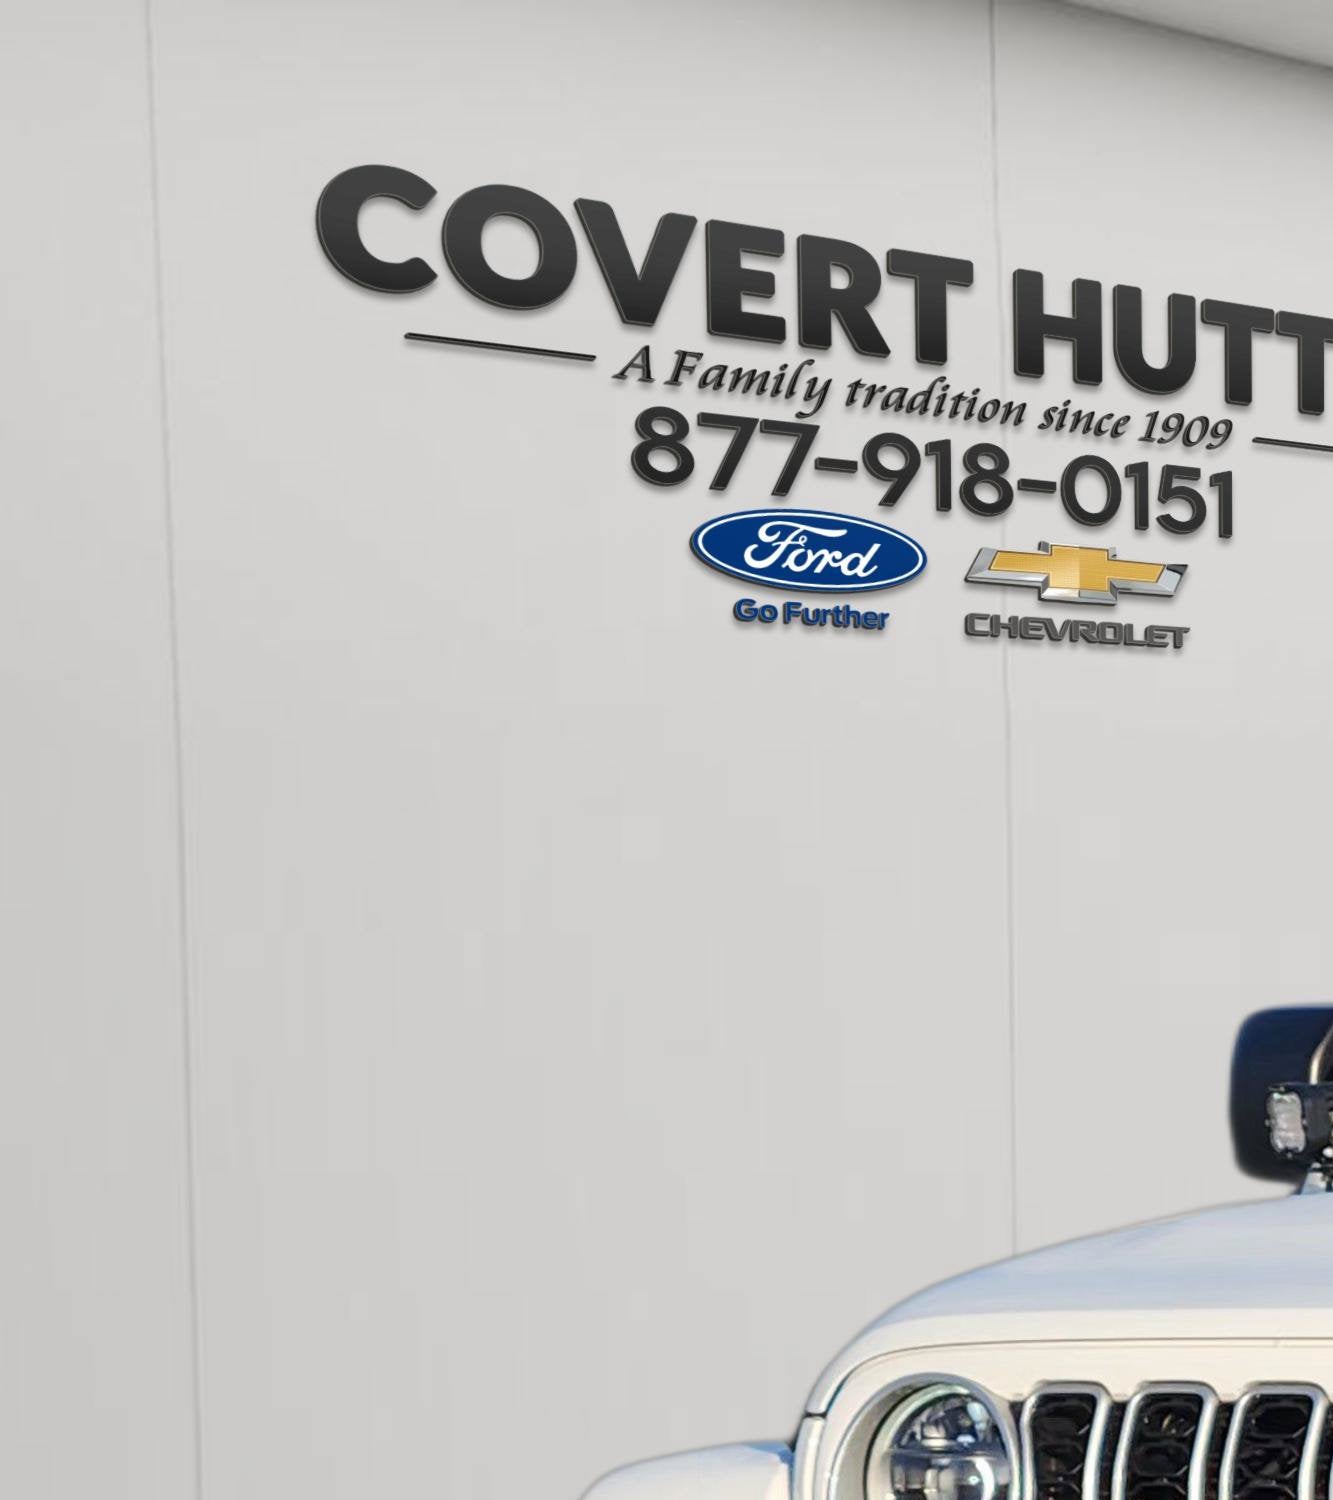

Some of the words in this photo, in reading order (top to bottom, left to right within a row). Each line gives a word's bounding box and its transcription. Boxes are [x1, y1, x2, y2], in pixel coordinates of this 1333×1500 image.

[316, 165, 975, 368] COVERT
[612, 345, 655, 384] A
[663, 349, 833, 420] Family
[845, 376, 1027, 427] tradition
[1037, 399, 1131, 439] since
[1138, 410, 1233, 450] 1909
[630, 406, 1233, 540] 877-918-0151
[743, 520, 882, 578] Ford
[732, 598, 779, 624] Go
[782, 601, 890, 630] Further
[964, 612, 1190, 650] CHEVROLET
